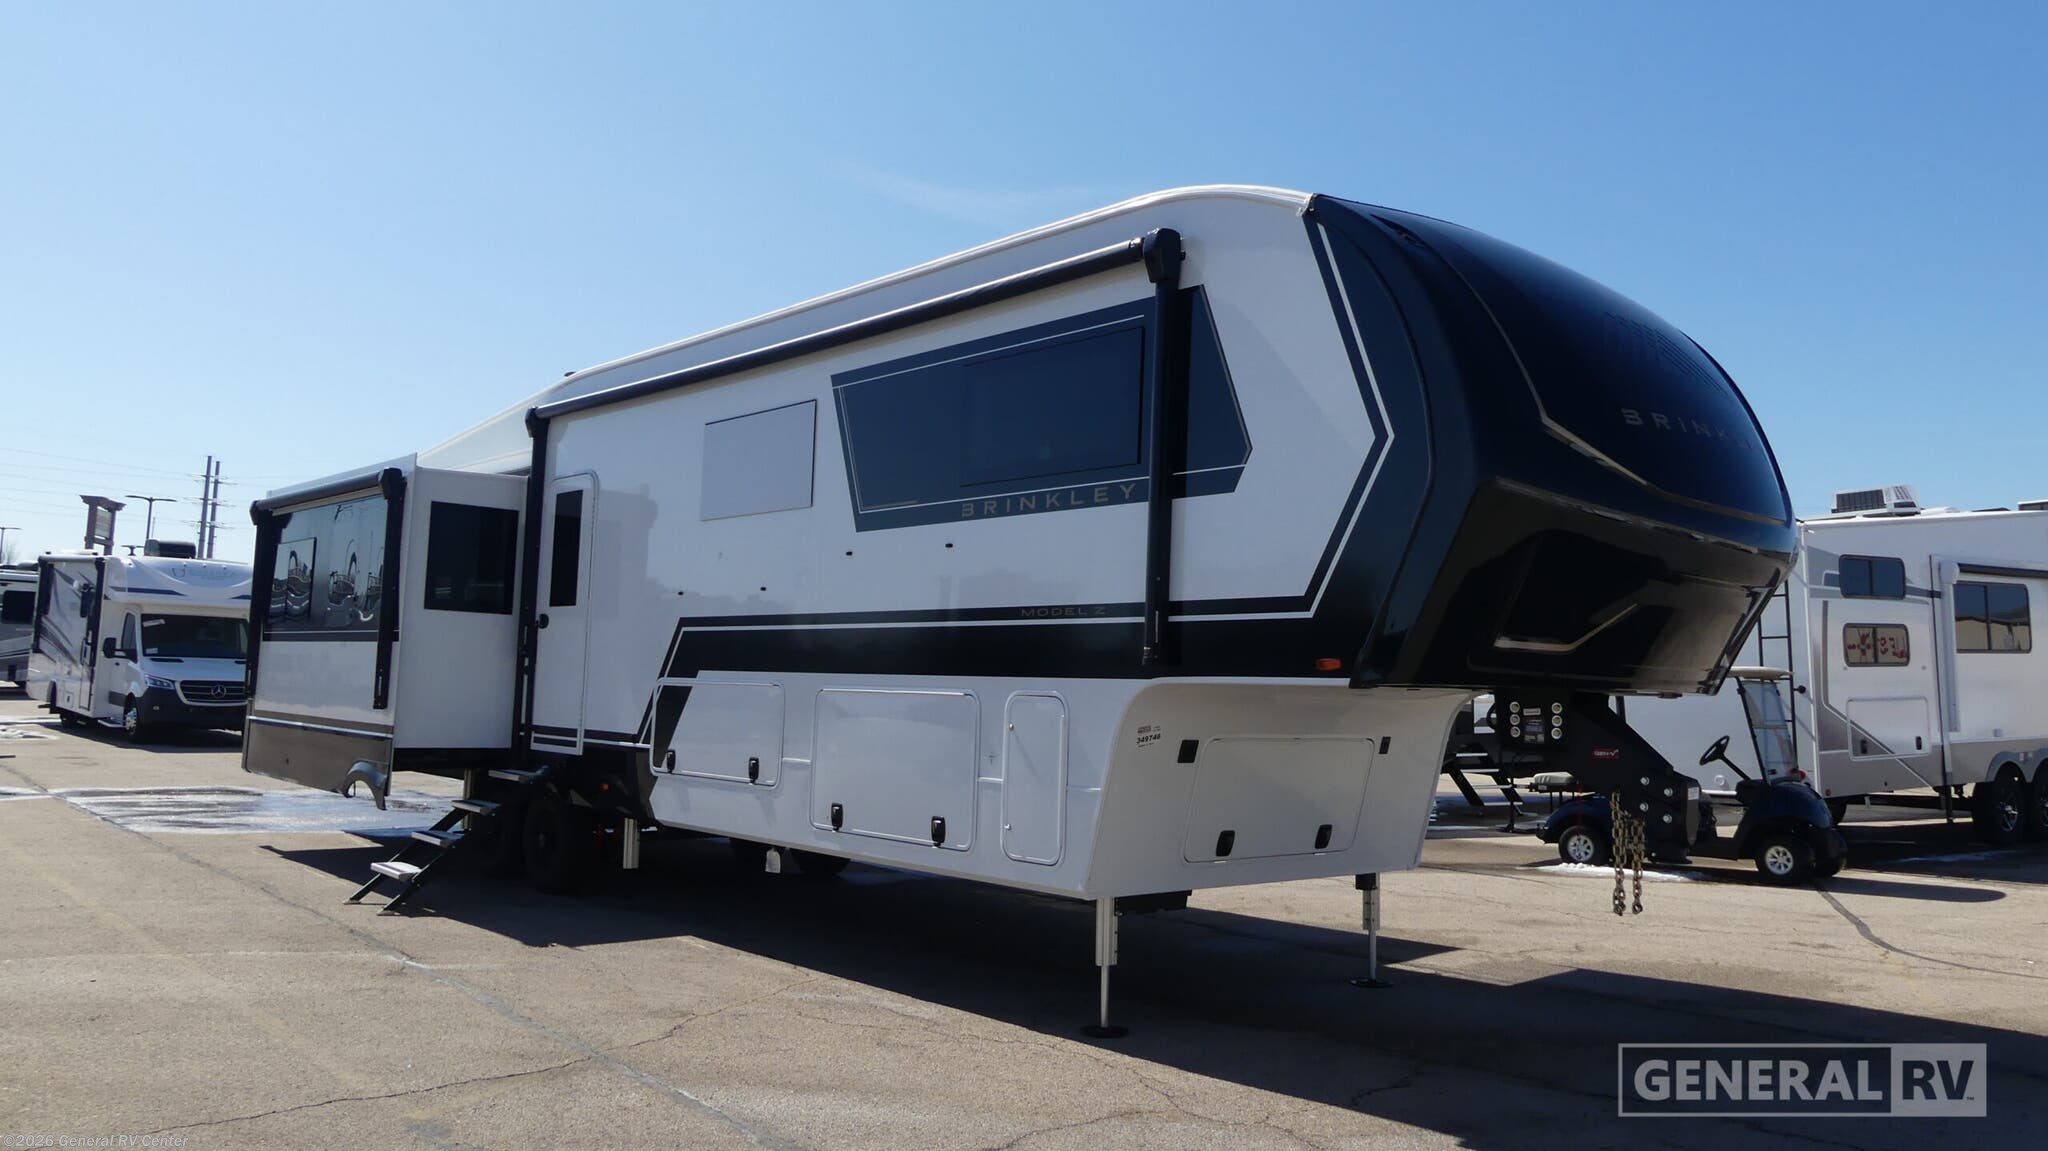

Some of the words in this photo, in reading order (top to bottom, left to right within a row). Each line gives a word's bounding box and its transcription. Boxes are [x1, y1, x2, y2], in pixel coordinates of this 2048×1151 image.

[961, 484, 1136, 517] BRINKLEY
[1021, 607, 1089, 617] MODEL
[1095, 607, 1105, 615] Z
